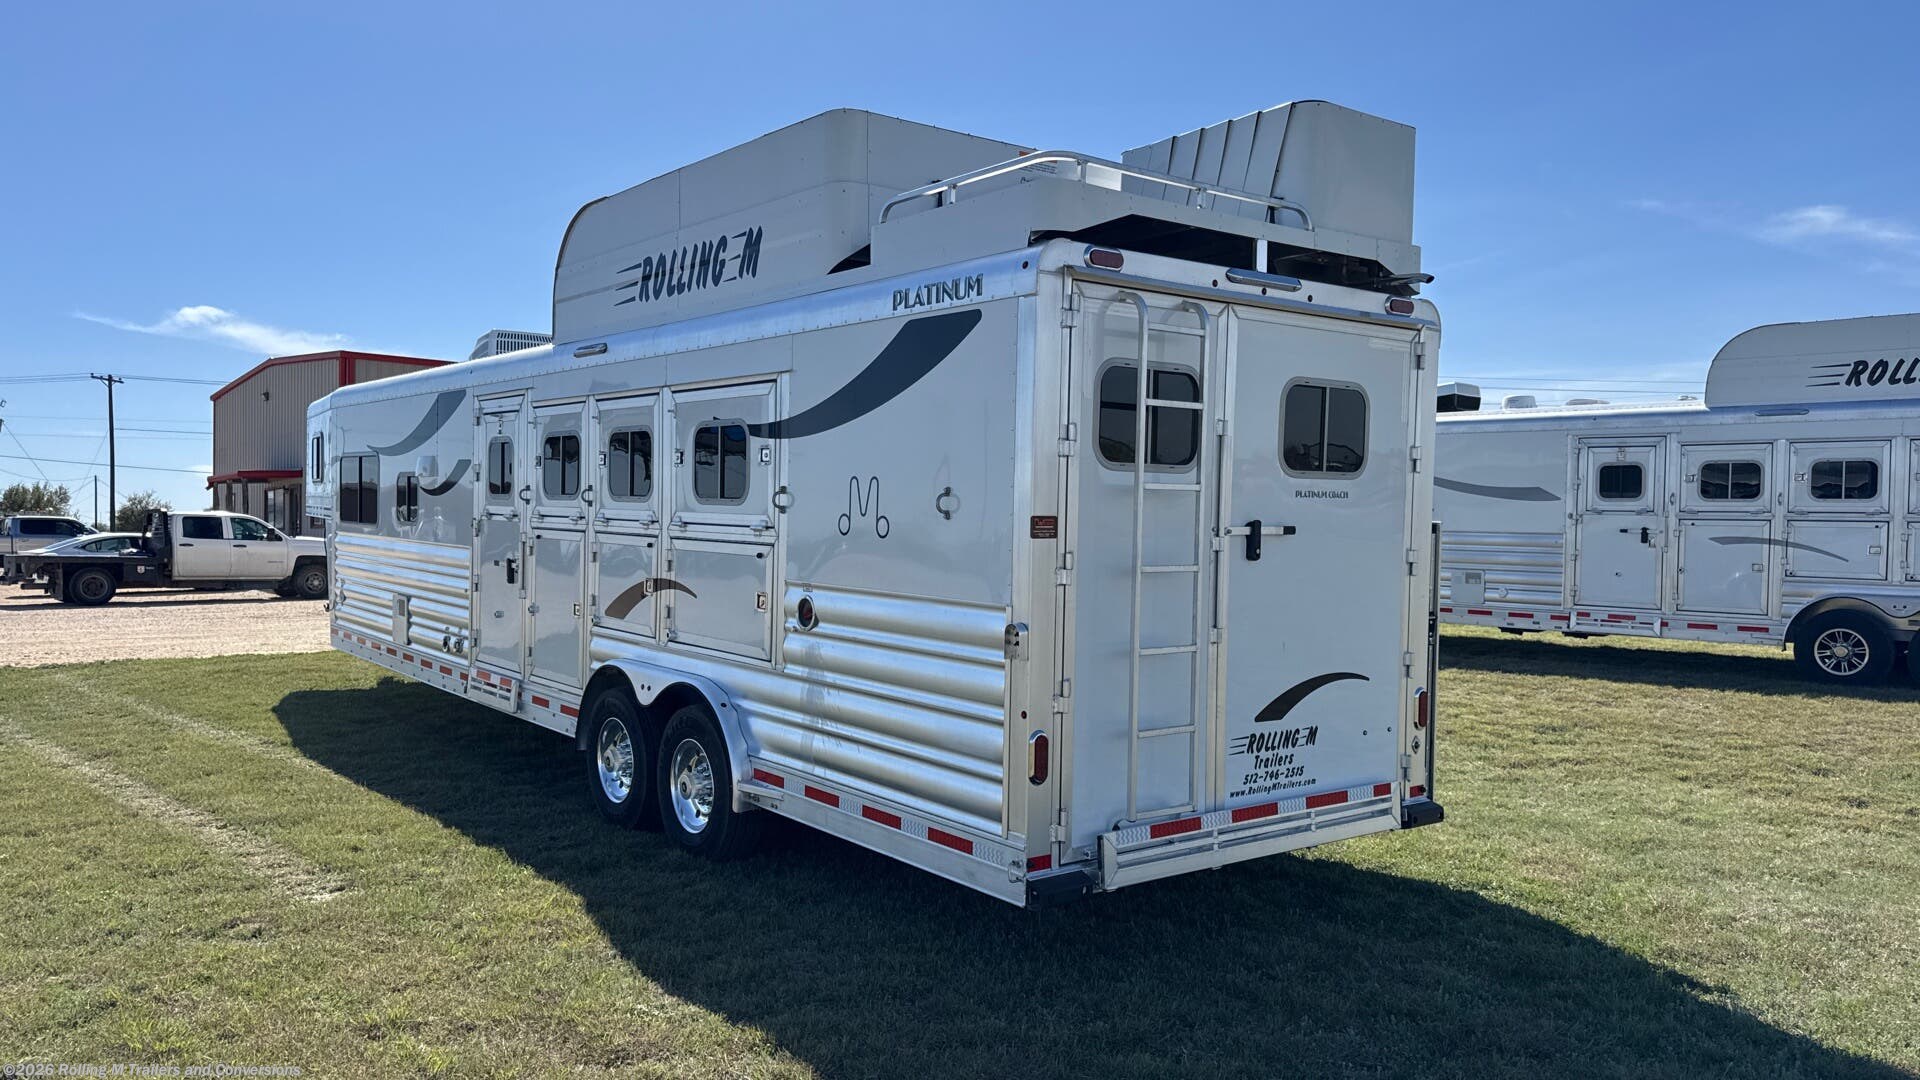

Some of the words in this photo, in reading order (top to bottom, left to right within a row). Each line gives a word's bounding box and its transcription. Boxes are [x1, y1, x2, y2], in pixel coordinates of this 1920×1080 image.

[638, 235, 728, 303] ROLLING
[738, 225, 763, 279] M
[892, 272, 984, 311] PLATINUM
[1844, 357, 1920, 387] ROLL
[1246, 728, 1300, 755] ROLLING
[1305, 725, 1319, 746] M
[1243, 765, 1305, 785] 512-746-2515
[1254, 752, 1295, 770] Trailers
[1229, 778, 1317, 799] www.RollingMTrailers.com
